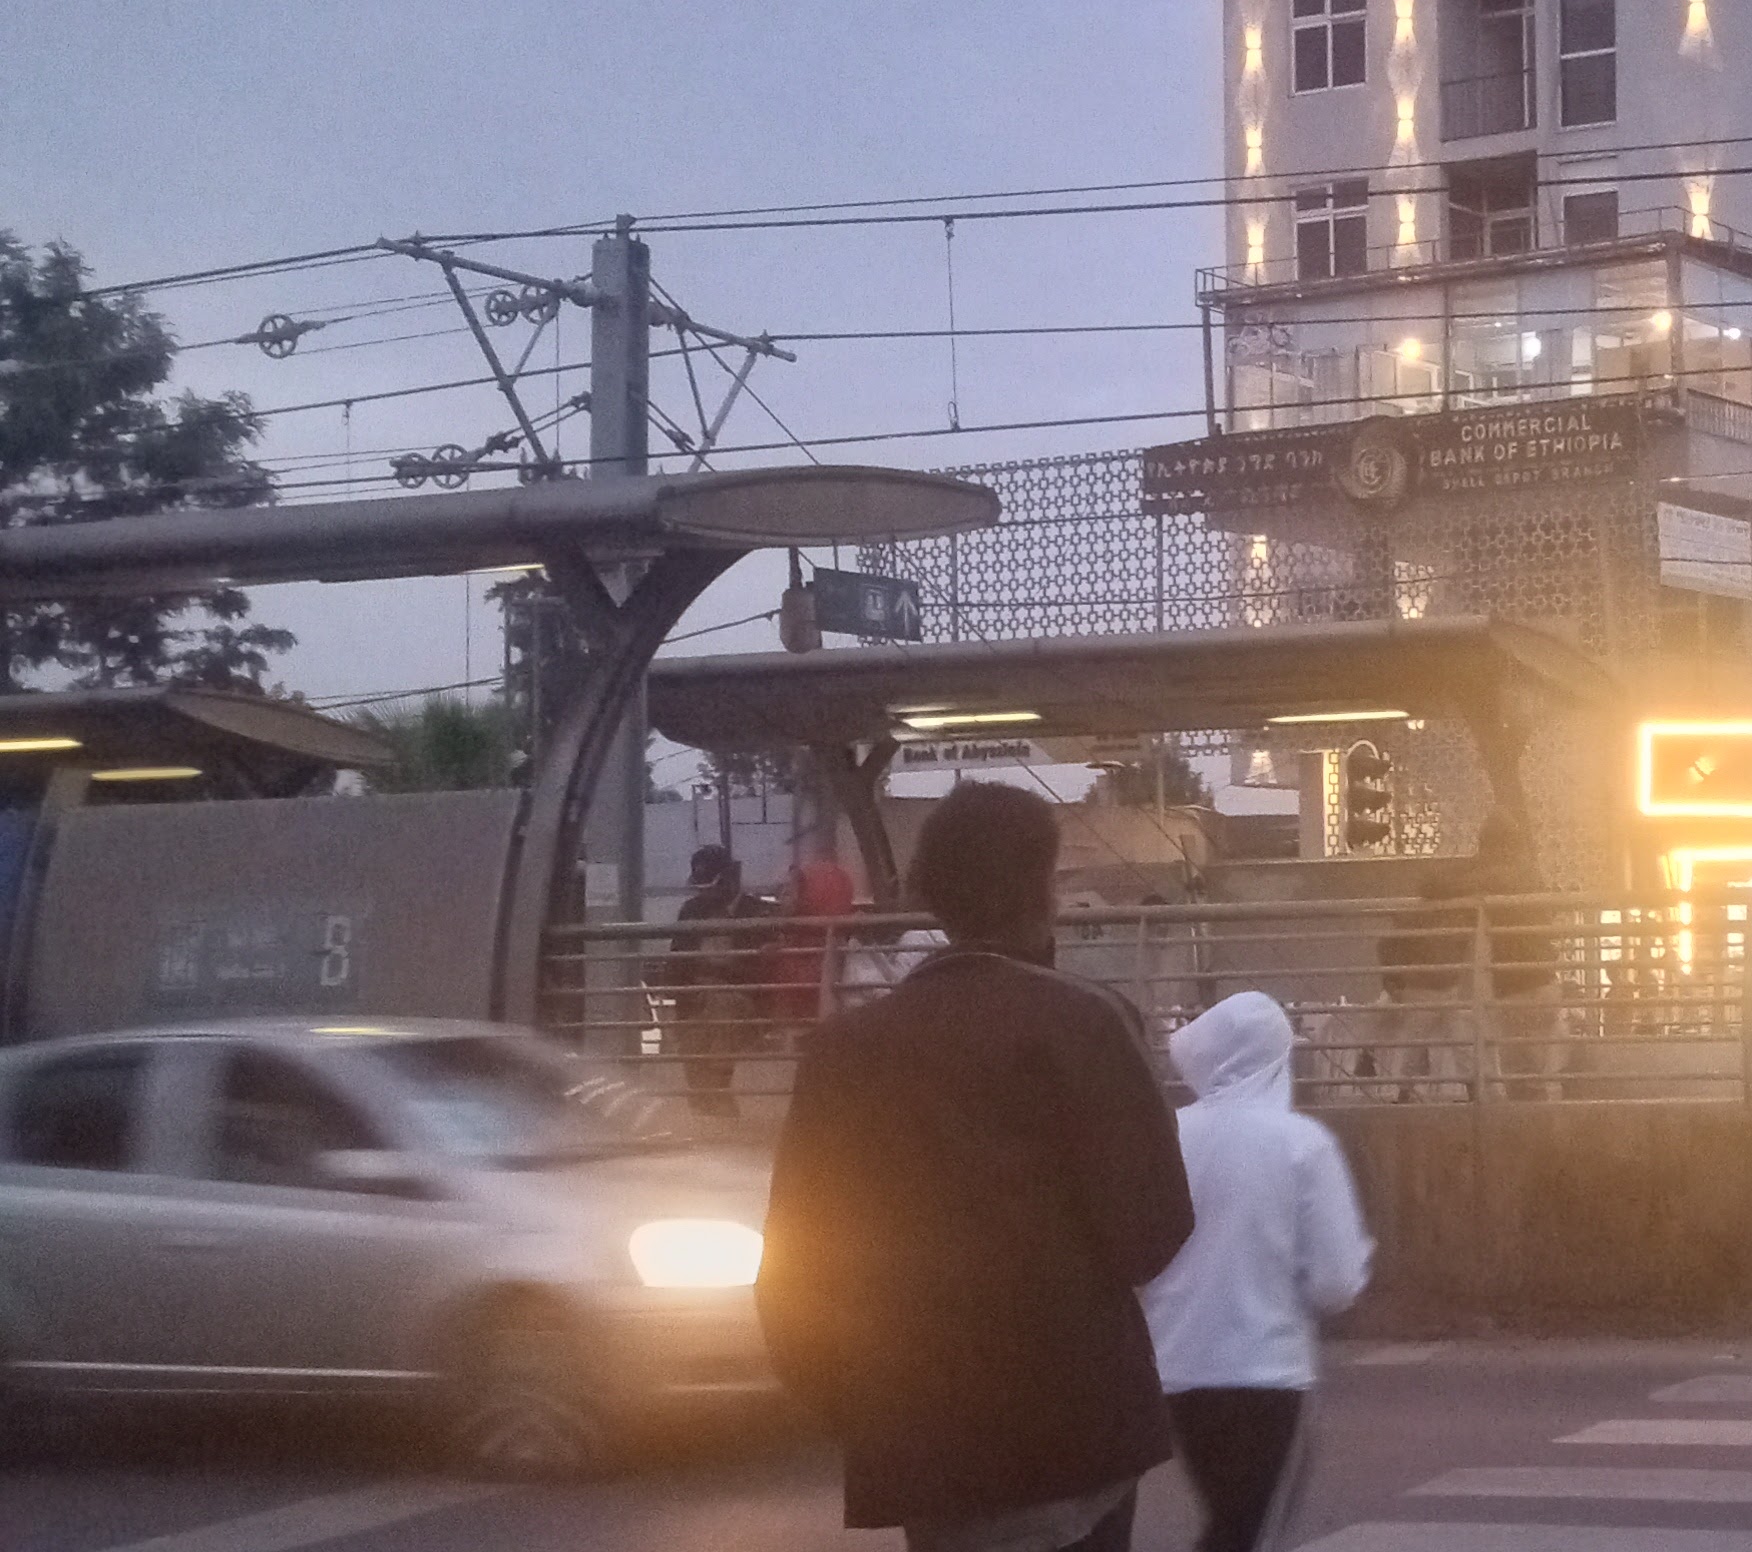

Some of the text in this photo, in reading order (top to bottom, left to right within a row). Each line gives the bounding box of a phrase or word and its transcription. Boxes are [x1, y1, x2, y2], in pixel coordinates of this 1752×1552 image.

[1461, 414, 1592, 442] COMMERCIAL
[1430, 432, 1623, 467] BANK OF ETHIOPIA
[902, 746, 938, 763] Bank
[943, 744, 957, 761] of
